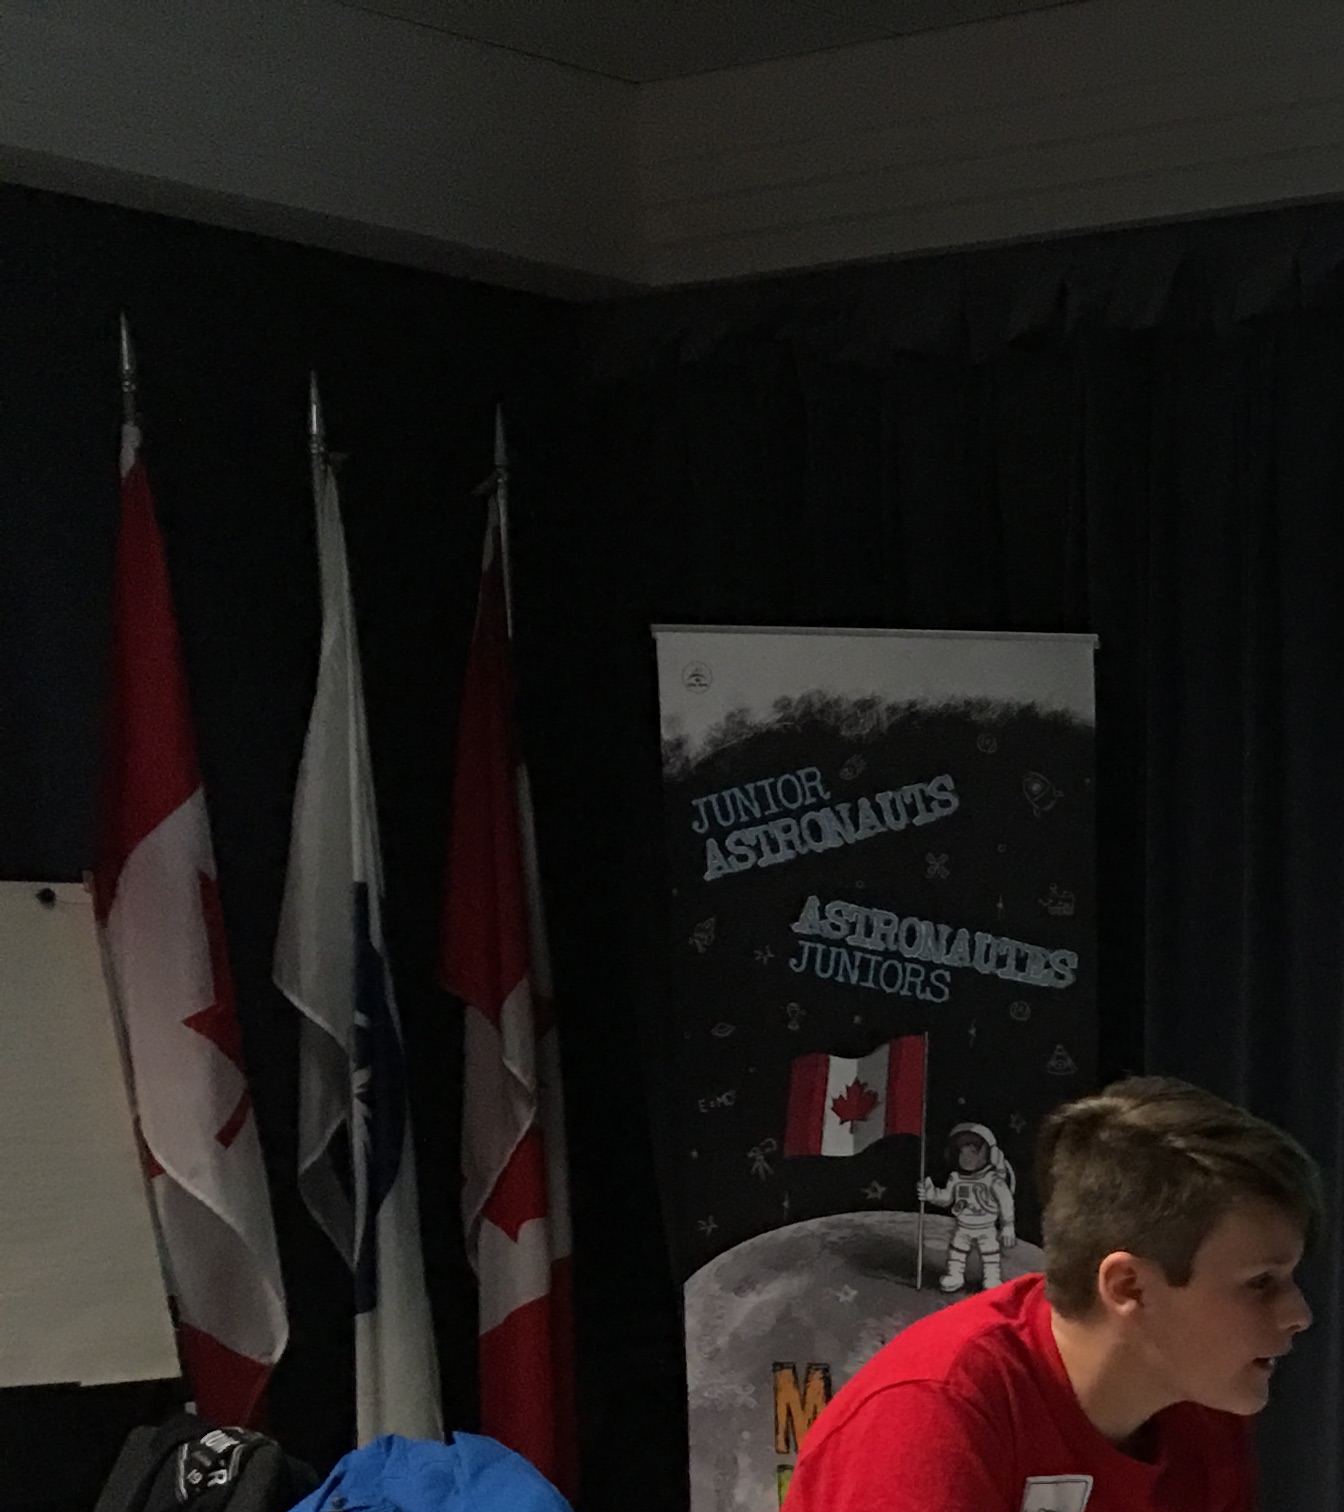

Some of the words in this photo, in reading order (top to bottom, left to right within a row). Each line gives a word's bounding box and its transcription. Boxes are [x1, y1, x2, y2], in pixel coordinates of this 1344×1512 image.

[691, 766, 830, 834] JUNIOR
[703, 774, 960, 881] ASTRONAUTS
[789, 939, 951, 1003] JUNIORS
[790, 895, 1079, 989] ASTRONAUTES
